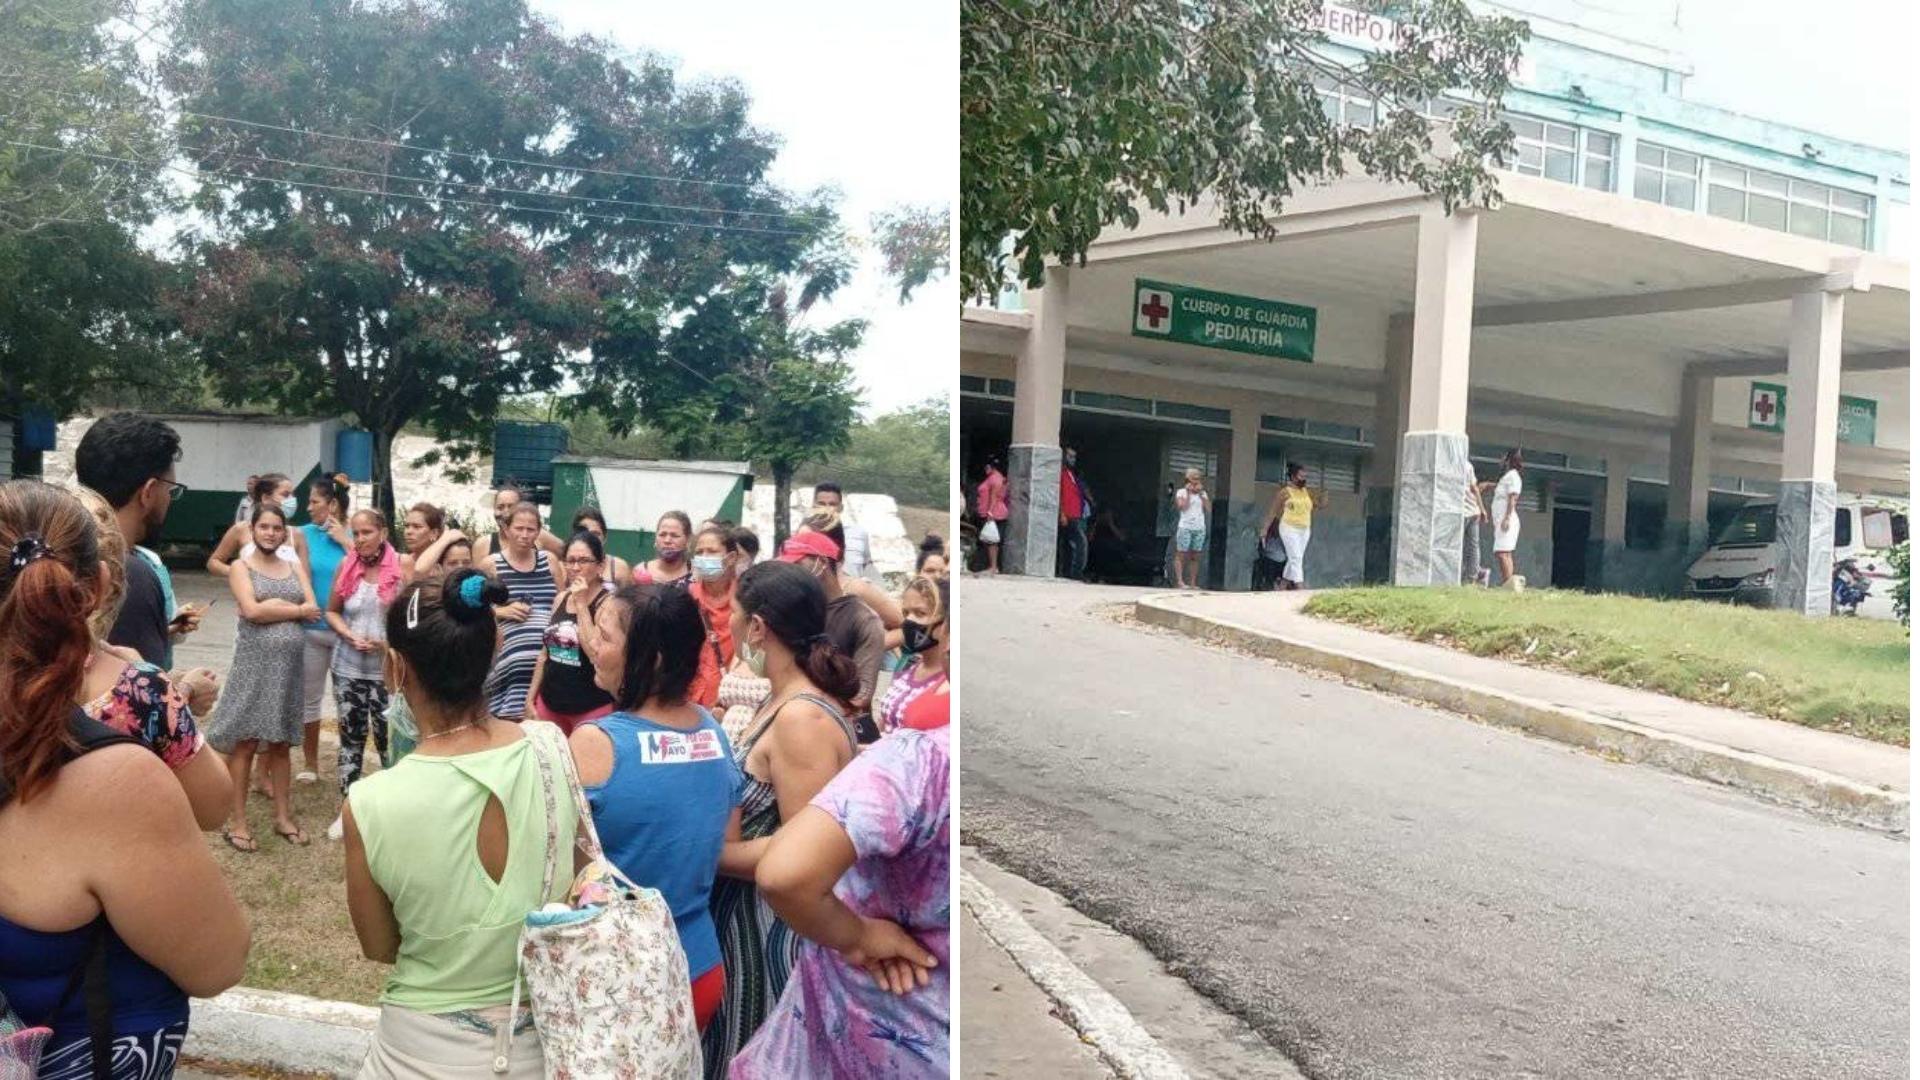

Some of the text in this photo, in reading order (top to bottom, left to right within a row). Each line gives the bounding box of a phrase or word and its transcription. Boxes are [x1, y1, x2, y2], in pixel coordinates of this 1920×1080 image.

[1304, 7, 1384, 42] UERPO
[1181, 297, 1308, 329] CUERPO DE GUARDIA
[1205, 321, 1283, 347] PEDIATRÍA
